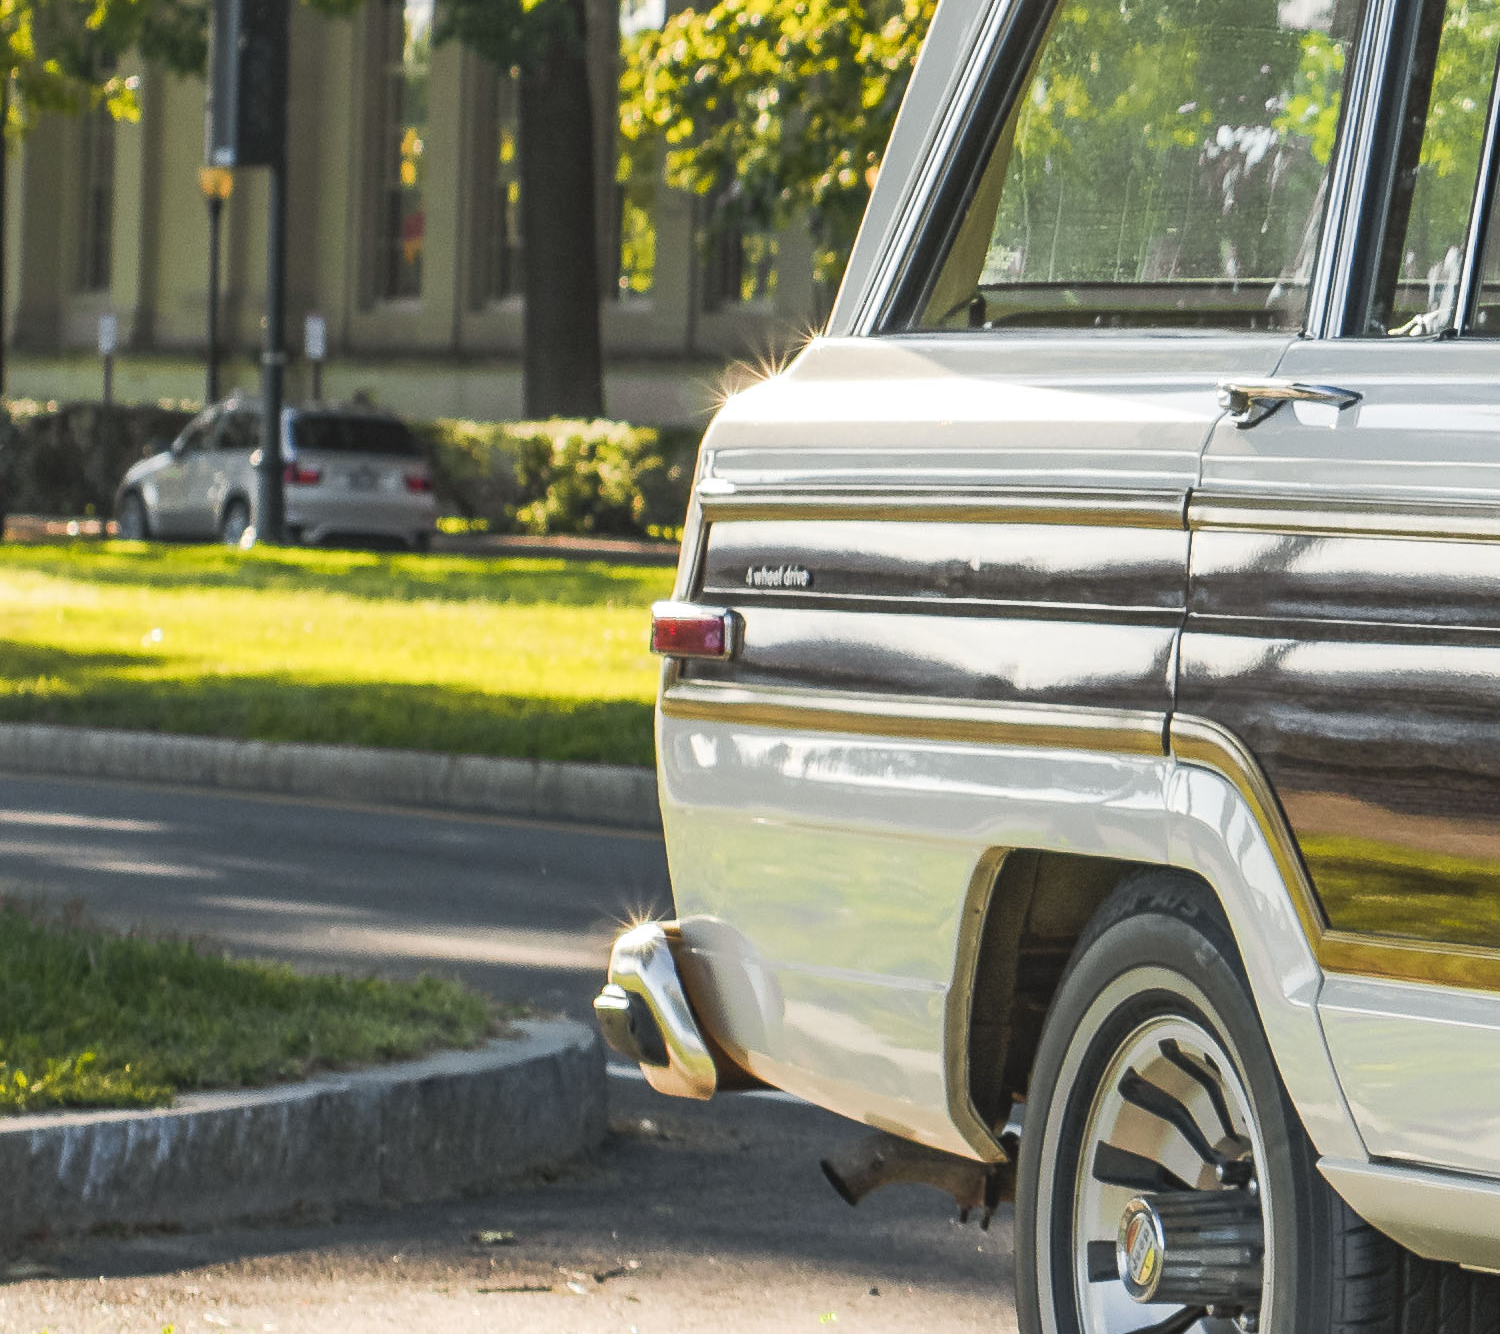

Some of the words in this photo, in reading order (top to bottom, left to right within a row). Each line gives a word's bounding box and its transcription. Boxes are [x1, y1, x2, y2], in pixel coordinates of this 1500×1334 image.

[745, 566, 753, 587] 4
[753, 564, 784, 587] wheel
[783, 564, 809, 587] drive
